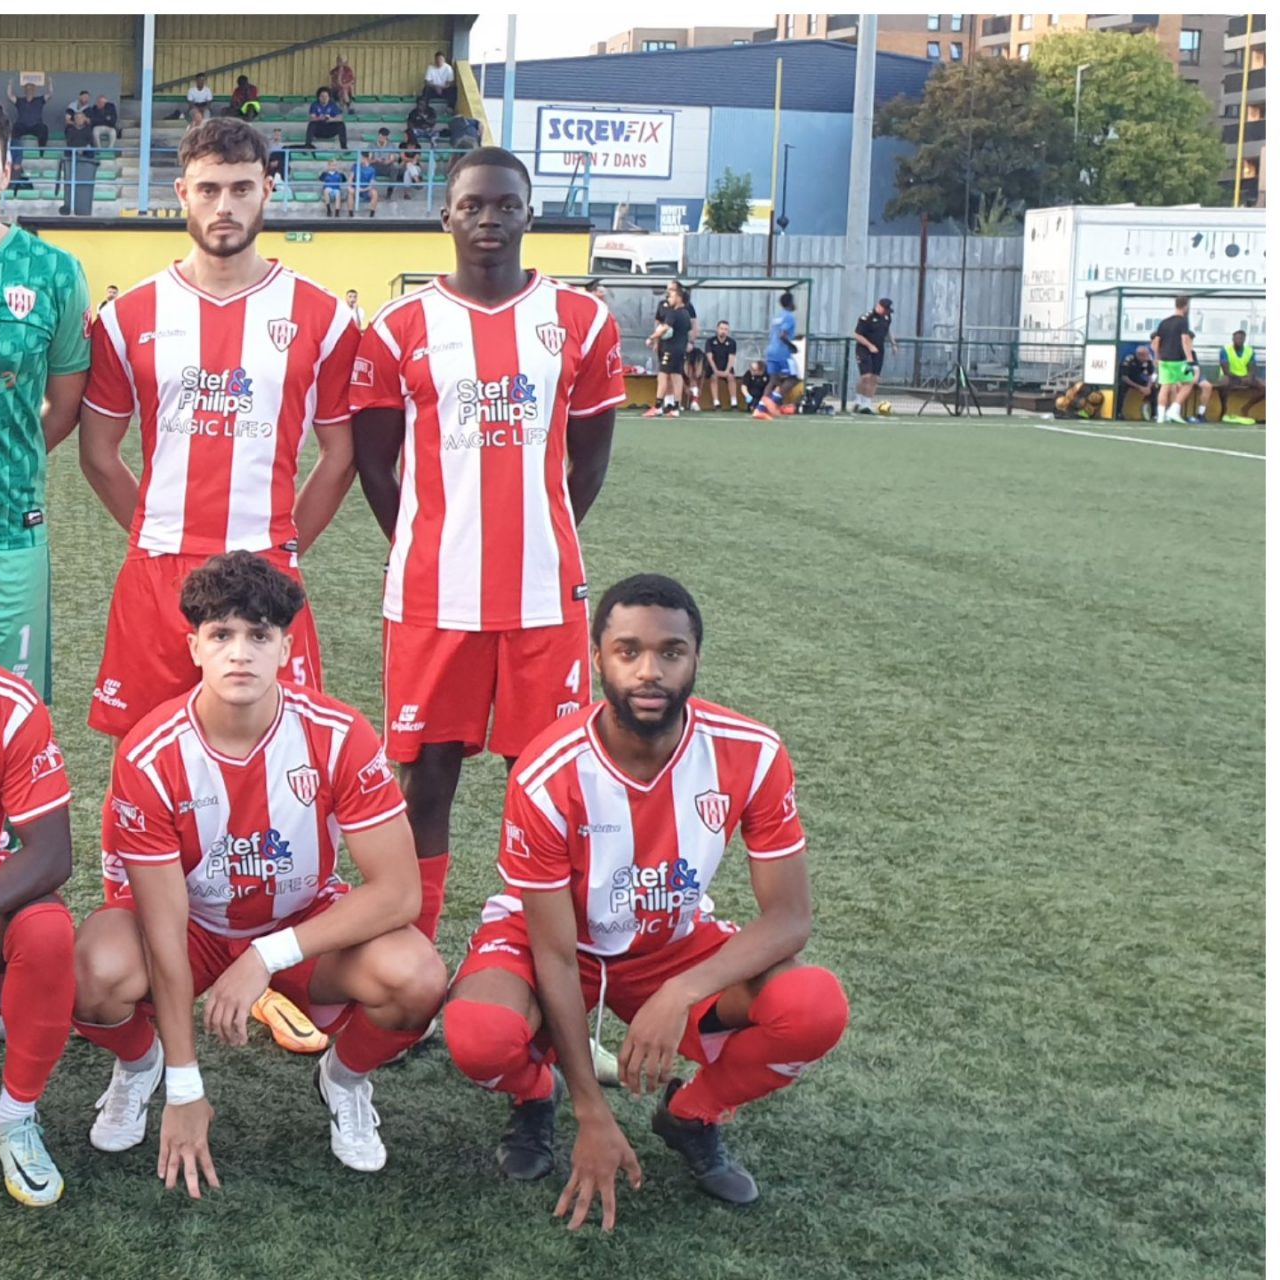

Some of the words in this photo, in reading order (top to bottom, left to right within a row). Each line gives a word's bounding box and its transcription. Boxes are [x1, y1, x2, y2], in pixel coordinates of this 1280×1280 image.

[548, 118, 664, 146] SCREWFIX
[563, 152, 598, 167] OPN
[602, 152, 610, 167] 7
[613, 153, 647, 168] DAYS
[1104, 266, 1175, 282] ENFIELD
[1180, 267, 1257, 283] KITCHEN
[178, 387, 253, 416] Philips
[458, 400, 538, 426] Philips
[18, 623, 31, 660] 1
[565, 659, 581, 694] 4
[206, 854, 294, 882] Philips
[265, 876, 302, 896] LIFE
[609, 885, 700, 914] Philips
